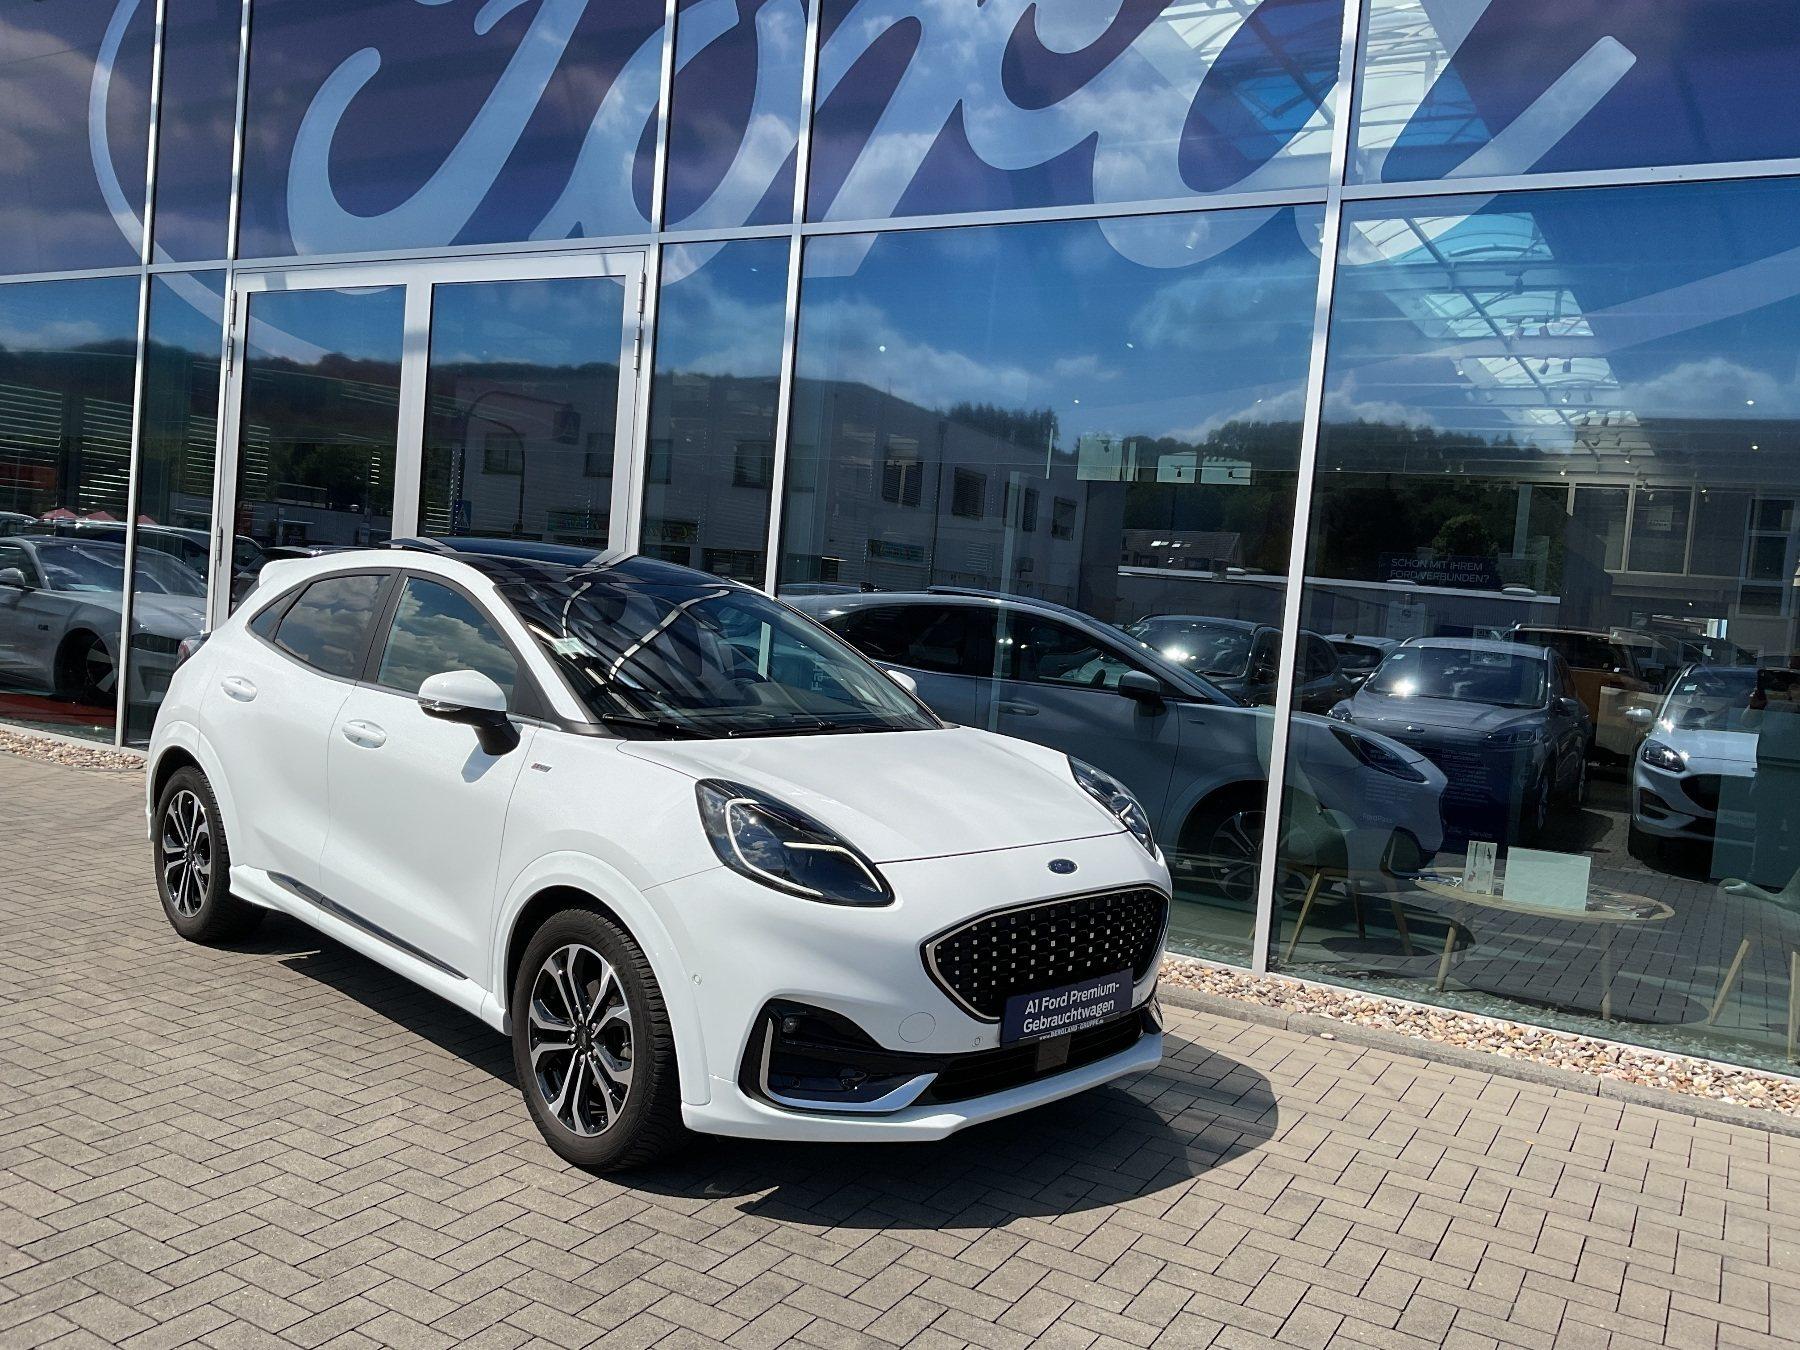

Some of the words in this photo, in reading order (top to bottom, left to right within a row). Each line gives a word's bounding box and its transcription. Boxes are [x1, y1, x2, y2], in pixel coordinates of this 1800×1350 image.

[1390, 569, 1418, 580] FORD
[1391, 558, 1427, 569] SCHON
[1429, 560, 1448, 570] MIT
[1024, 998, 1039, 1015] A1
[1041, 991, 1068, 1012] Ford
[1070, 981, 1120, 1005] Premium-
[1023, 999, 1115, 1033] Gebrauchtwagen
